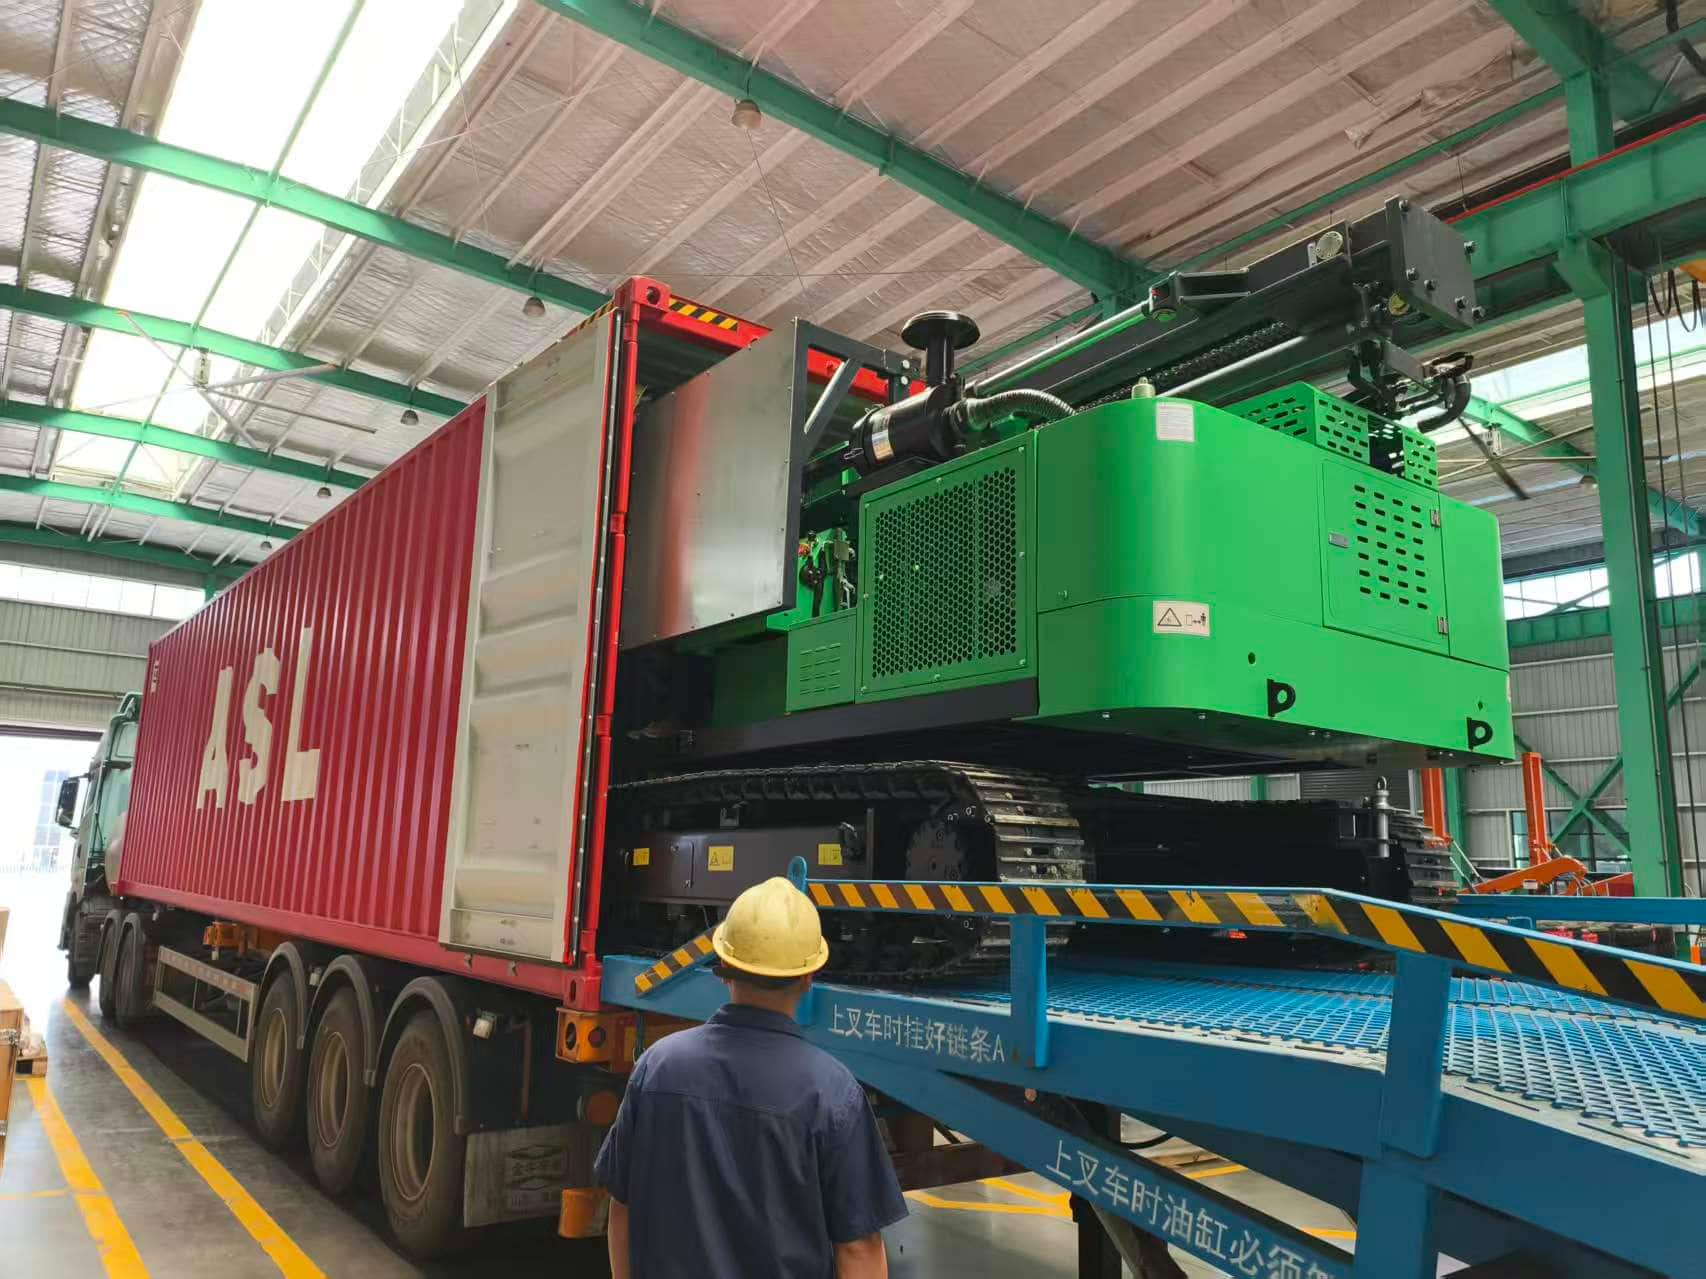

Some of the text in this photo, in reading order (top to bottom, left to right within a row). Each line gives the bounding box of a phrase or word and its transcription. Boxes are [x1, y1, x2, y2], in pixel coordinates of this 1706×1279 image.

[196, 627, 321, 809] ASL
[828, 1004, 1006, 1063] 上叉车时挂好链条A
